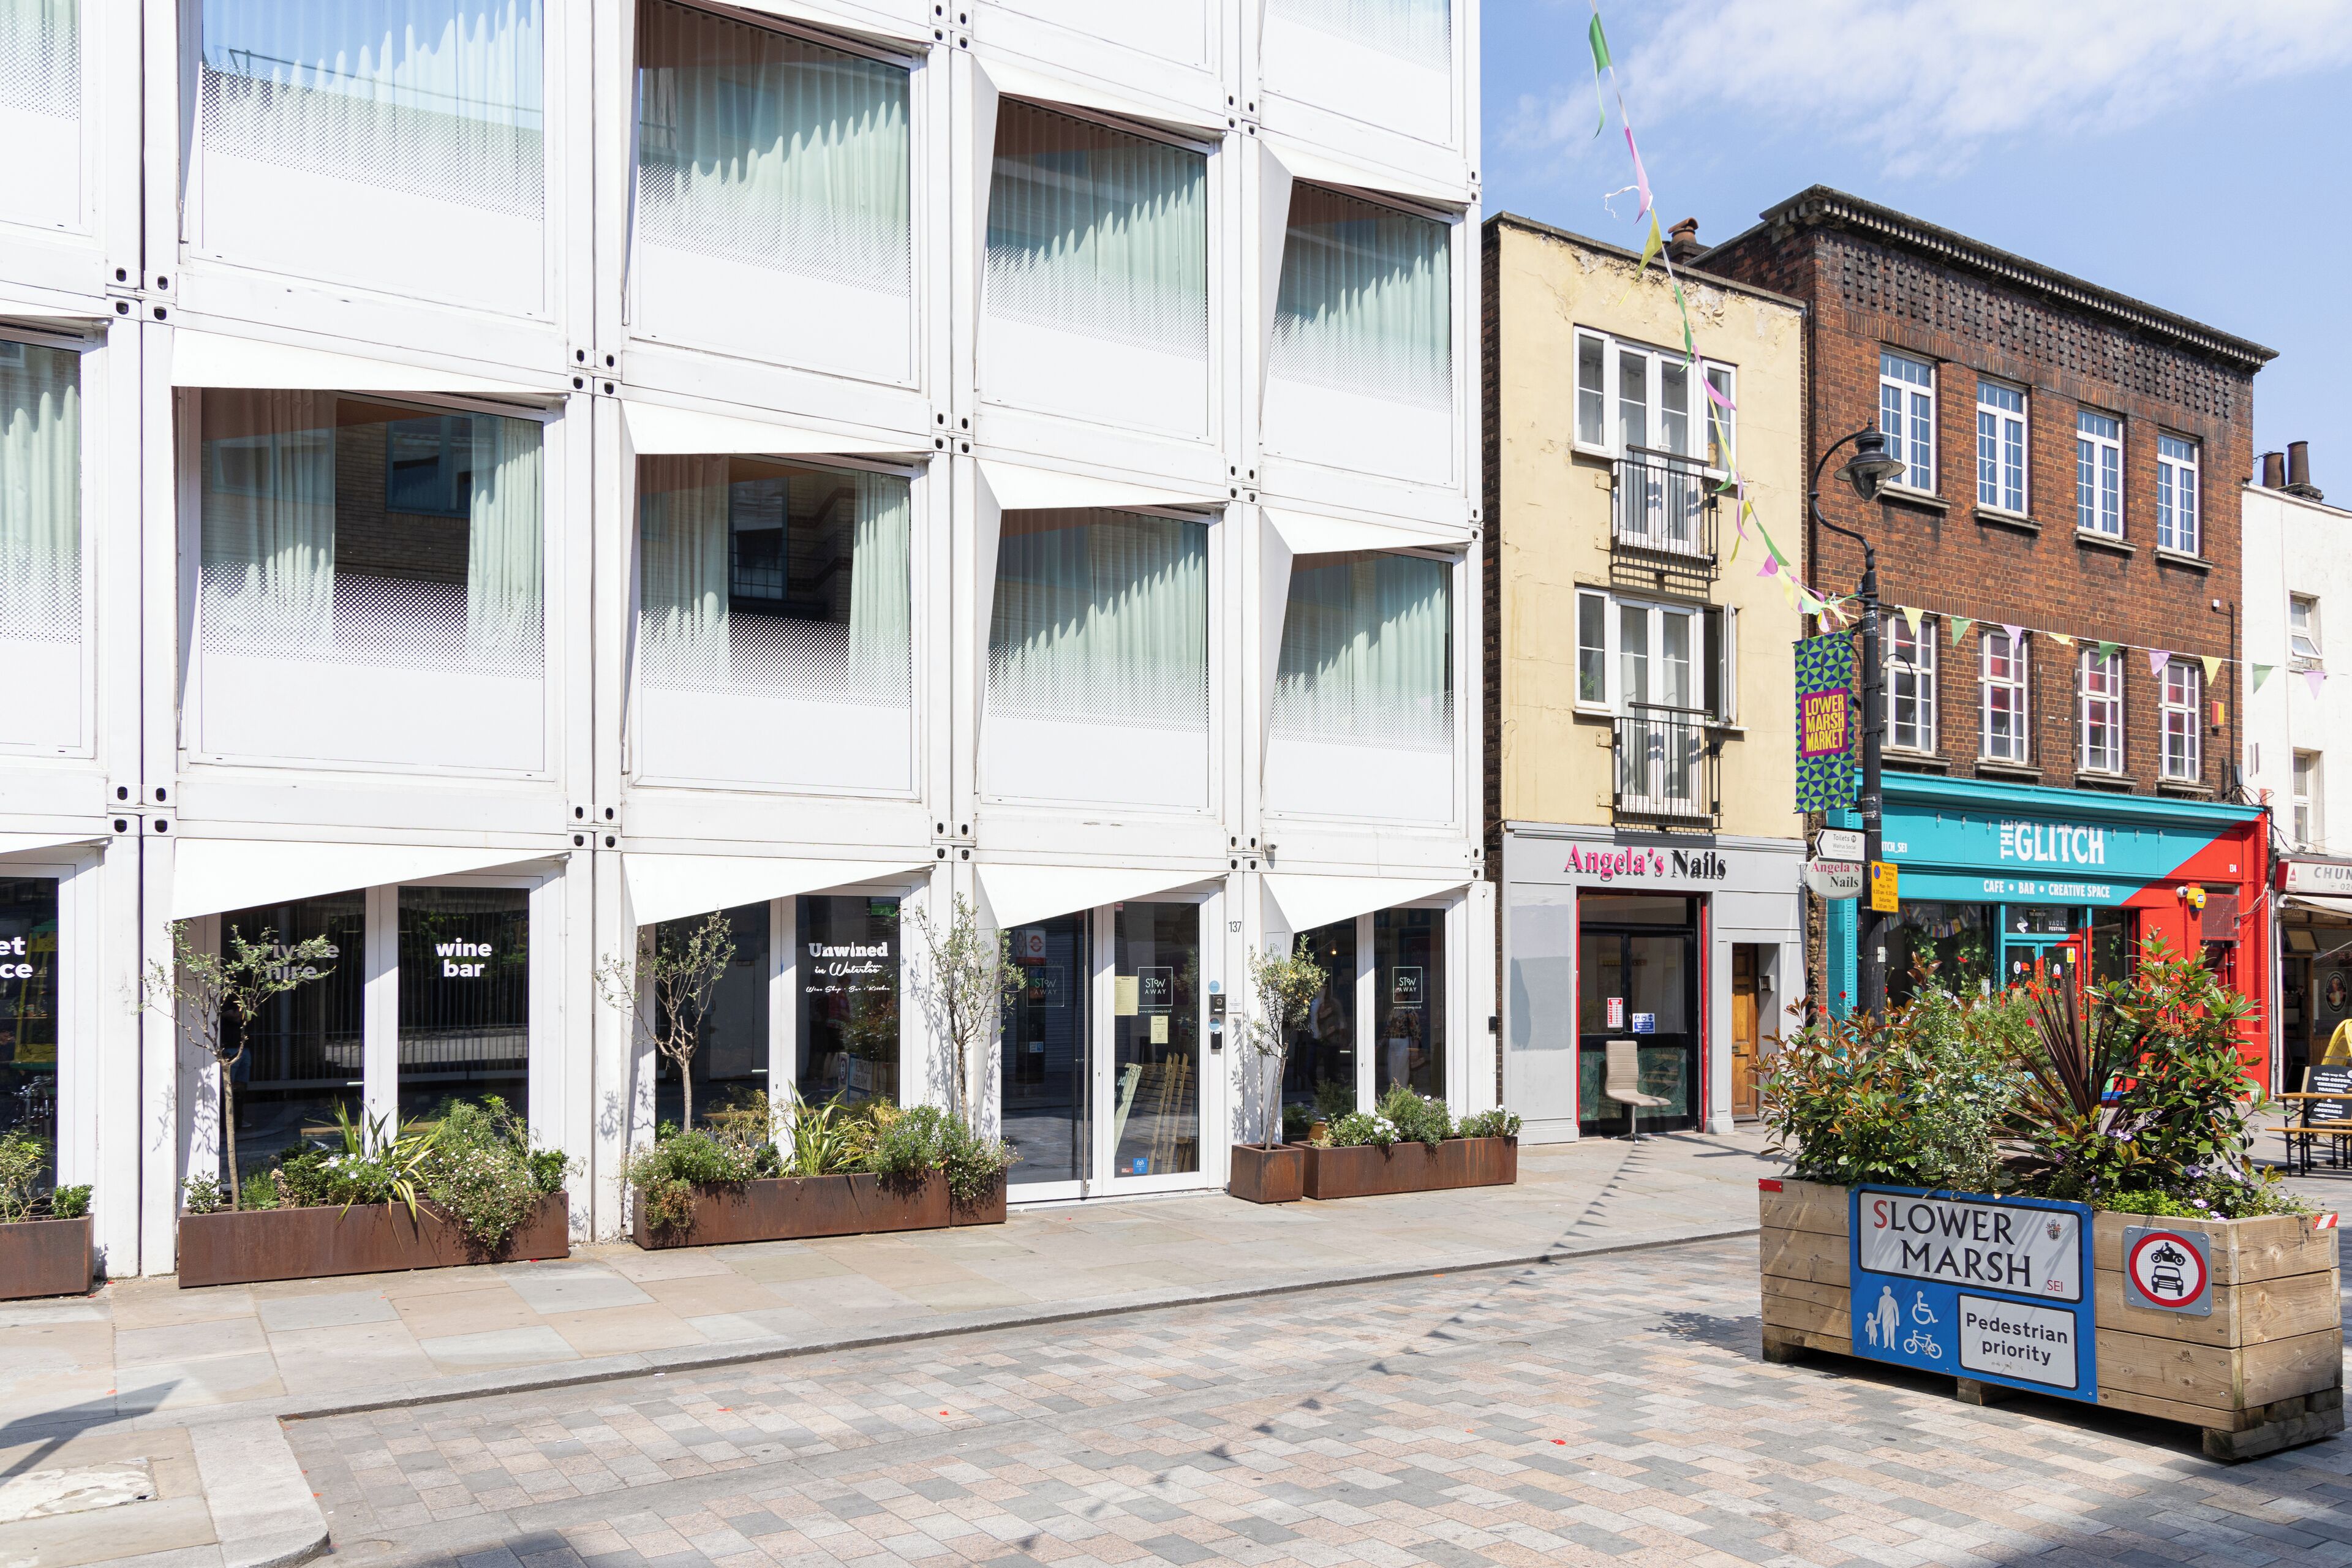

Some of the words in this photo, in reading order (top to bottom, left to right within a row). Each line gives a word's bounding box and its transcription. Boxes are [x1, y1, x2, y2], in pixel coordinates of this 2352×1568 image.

[1805, 694, 1844, 716] LOWER
[1806, 712, 1844, 733] MARSH
[1806, 728, 1844, 752] MARKET
[2000, 820, 2013, 859] THE
[2015, 821, 2105, 864] GLITCH
[1566, 844, 1664, 880] Angela's
[1672, 850, 1726, 880] Nails
[1811, 862, 1860, 875] Angela's
[1830, 876, 1858, 888] Nails
[1984, 880, 2004, 893] CAFE
[2019, 882, 2035, 895] BAR
[2048, 883, 2085, 897] CREATIVE
[2087, 885, 2110, 898] SPACE
[1229, 921, 1242, 932] 137
[435, 937, 492, 957] wine
[808, 941, 888, 957] Unwined
[443, 959, 485, 977] bar
[815, 965, 826, 974] in
[829, 960, 883, 976] Waterloo
[1873, 1199, 2015, 1245] SLOWER
[1900, 1239, 2031, 1287] MARSH
[1967, 1312, 2068, 1344] Pedestrian
[1982, 1340, 2051, 1366] priority
